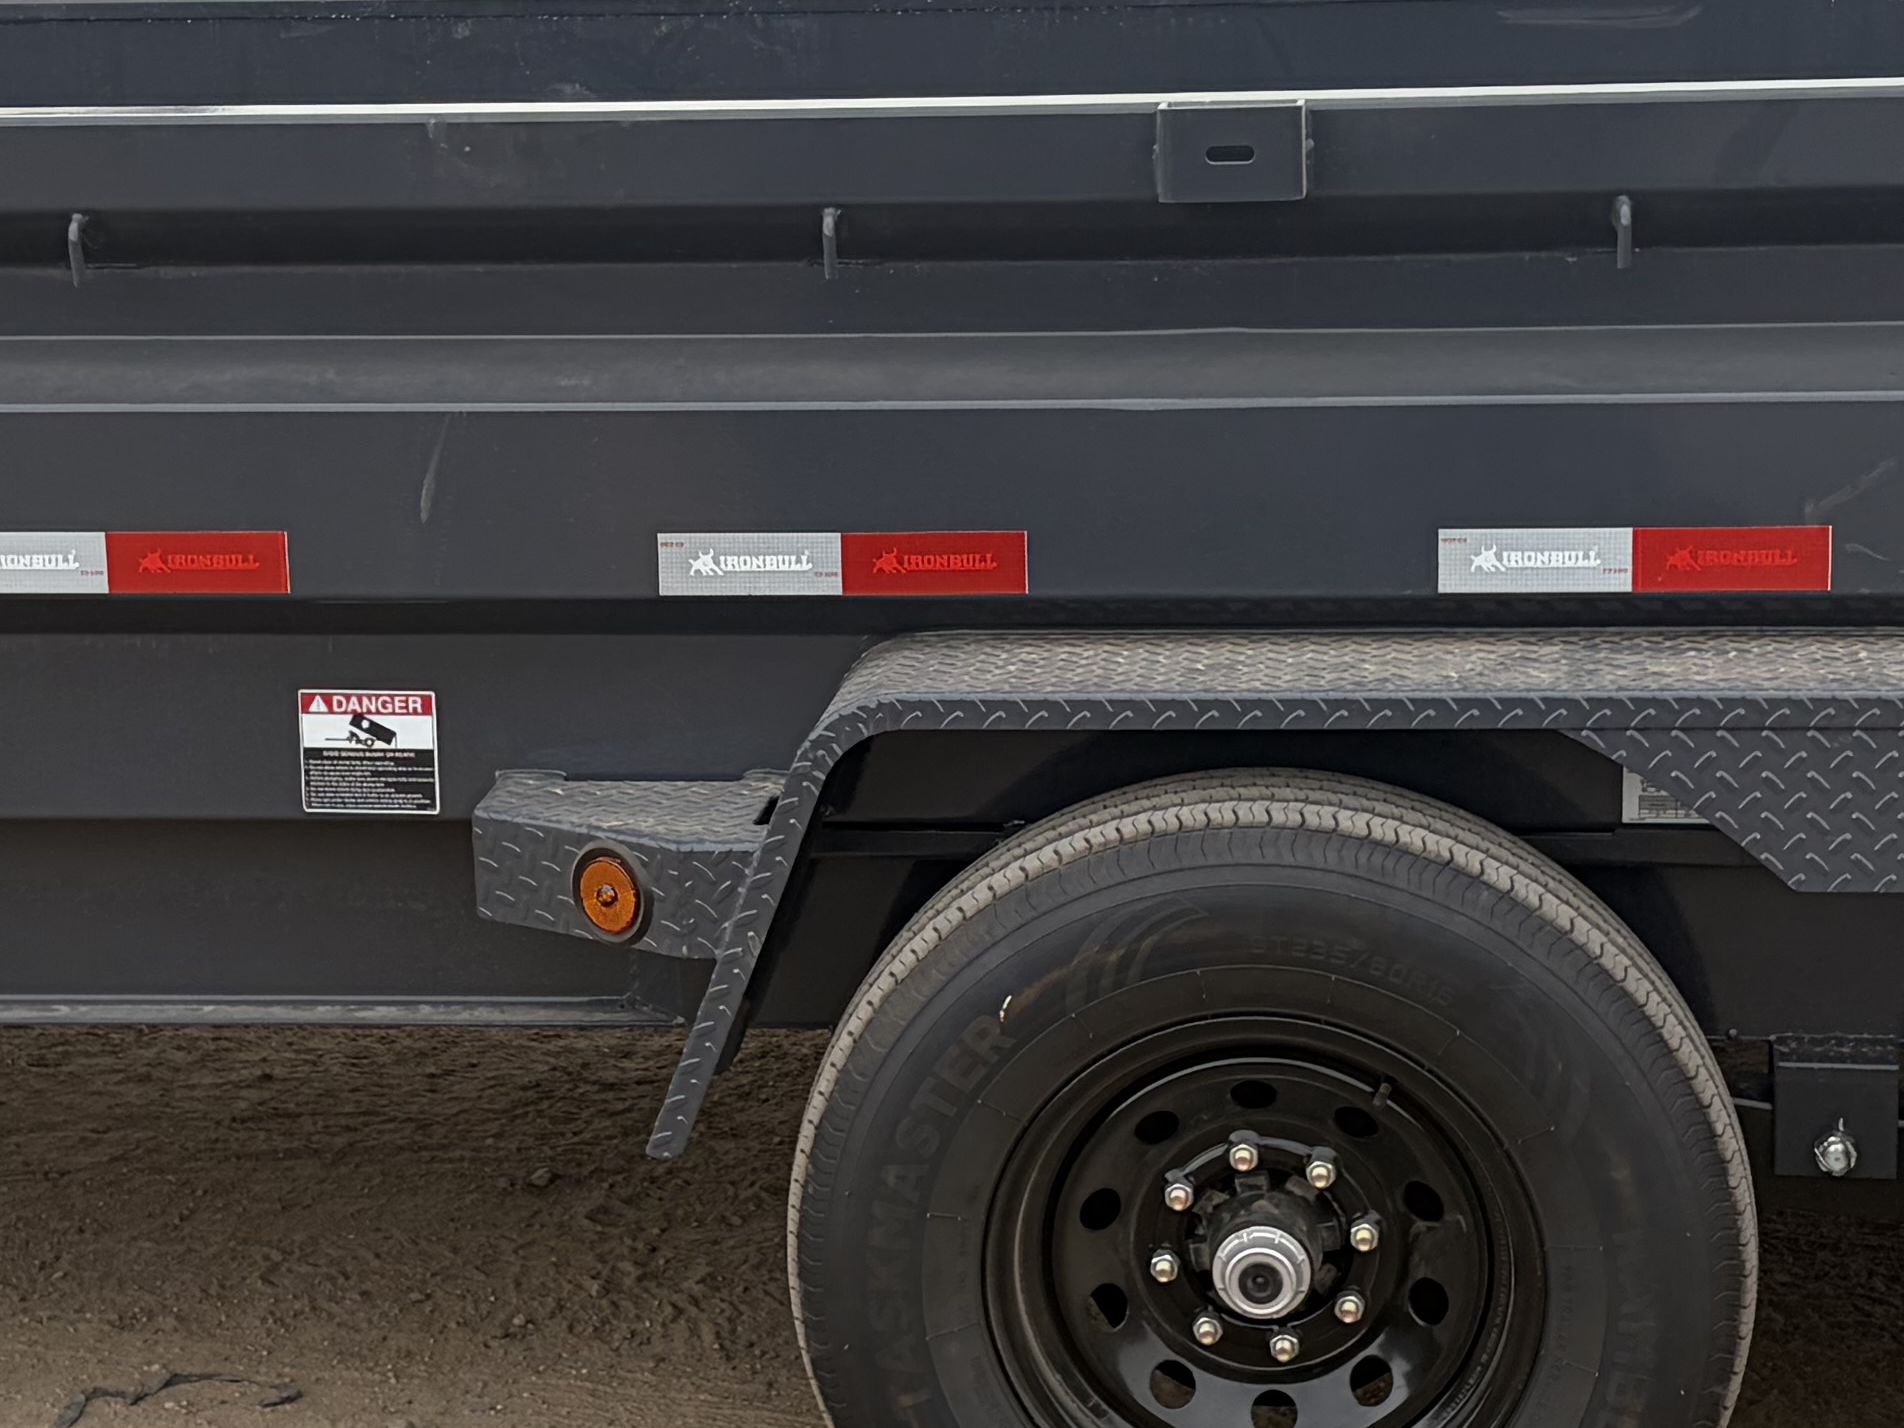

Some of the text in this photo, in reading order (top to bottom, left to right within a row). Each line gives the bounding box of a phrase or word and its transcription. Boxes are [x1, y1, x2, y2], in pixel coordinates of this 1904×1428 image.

[167, 553, 260, 570] IRONBULL
[718, 552, 813, 571] IRONBULL
[902, 553, 998, 571] IRONBULL
[1502, 549, 1601, 568] IRONBULL
[332, 695, 423, 713] DANGER
[860, 1007, 1022, 1426] TASKMASTER
